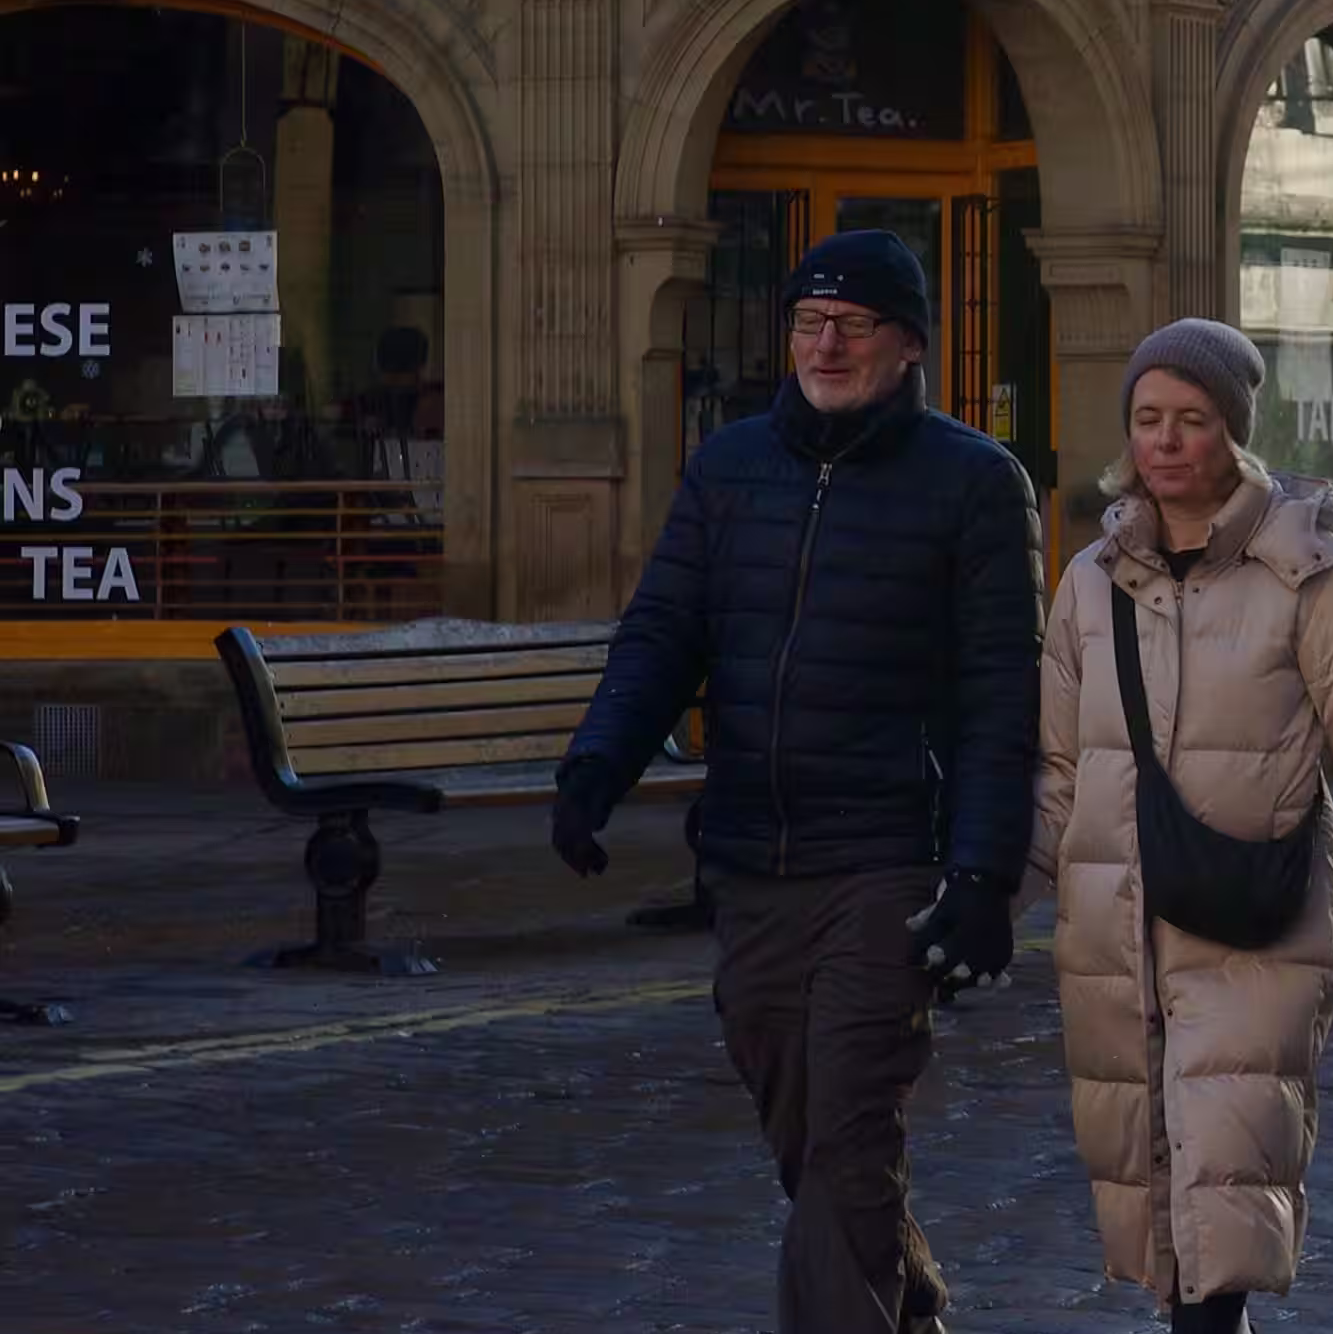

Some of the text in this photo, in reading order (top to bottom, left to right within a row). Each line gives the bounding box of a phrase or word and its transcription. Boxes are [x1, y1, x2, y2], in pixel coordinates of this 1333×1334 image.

[733, 87, 826, 123] Mr.
[3, 302, 111, 357] ESE
[20, 546, 140, 601] TEA
